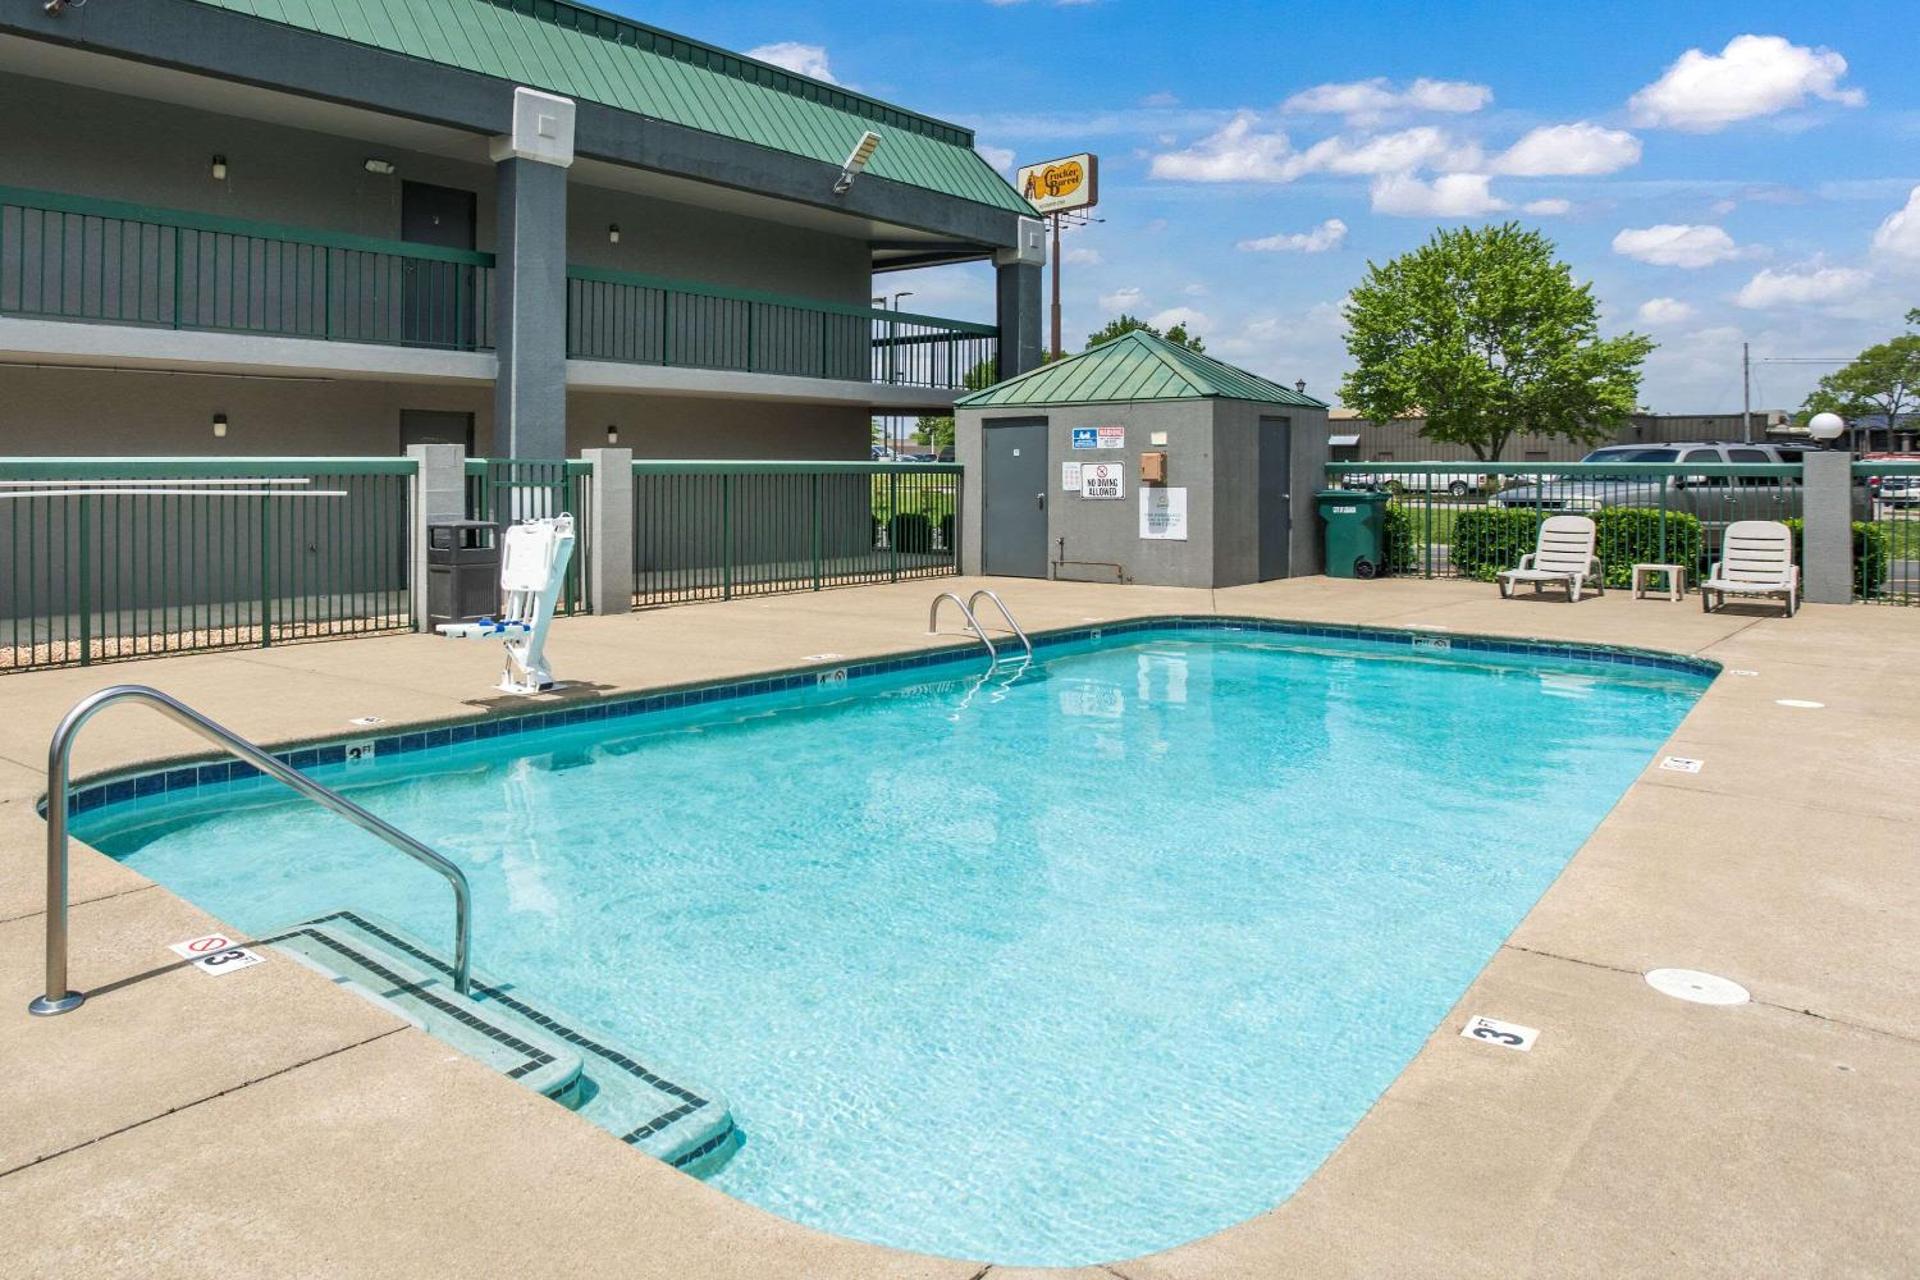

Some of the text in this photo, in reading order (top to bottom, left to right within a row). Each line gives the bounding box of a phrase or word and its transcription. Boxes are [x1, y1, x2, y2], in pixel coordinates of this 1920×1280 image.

[1087, 478, 1118, 487] NO DIVING
[1089, 487, 1117, 496] ALLOWED
[204, 950, 245, 966] 3
[1472, 1027, 1525, 1046] 3
